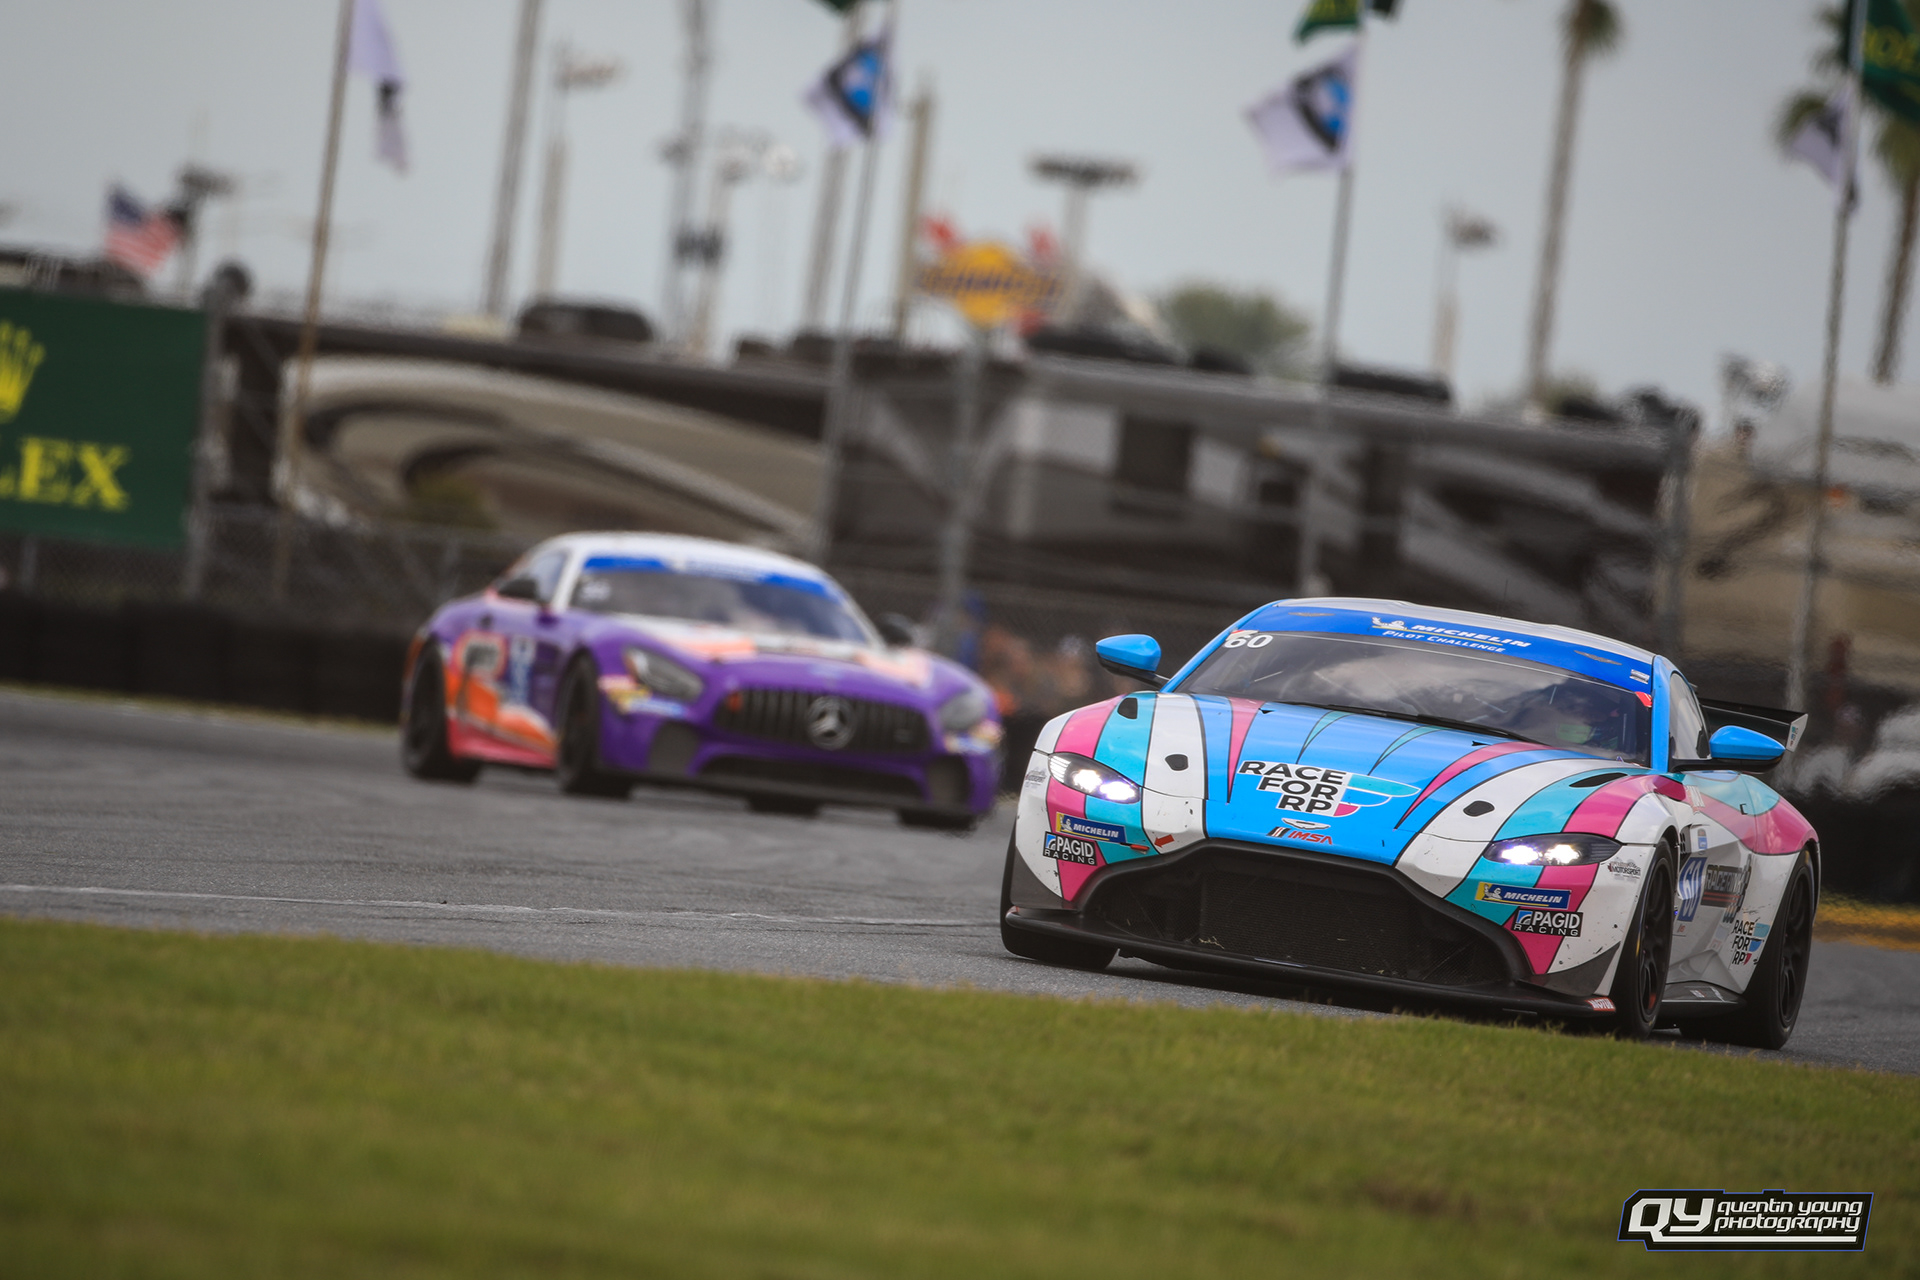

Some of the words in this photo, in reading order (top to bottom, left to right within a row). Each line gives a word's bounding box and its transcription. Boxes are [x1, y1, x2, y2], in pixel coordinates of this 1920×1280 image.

[1224, 634, 1274, 649] 60
[1411, 624, 1532, 648] MICHELIN
[1238, 760, 1347, 785] RACE
[1258, 776, 1338, 800] FOR
[1278, 795, 1332, 813] RP
[1073, 823, 1119, 838] MICHELIN
[1288, 830, 1333, 845] IMSA
[1056, 836, 1094, 858] PAGID
[1044, 849, 1095, 865] RACING
[1503, 891, 1563, 904] MICHELIN
[1532, 912, 1581, 929] PAGID
[1731, 919, 1755, 935] RACE
[1513, 924, 1579, 936] RACING
[1731, 935, 1751, 951] FOR
[1731, 951, 1746, 965] RP
